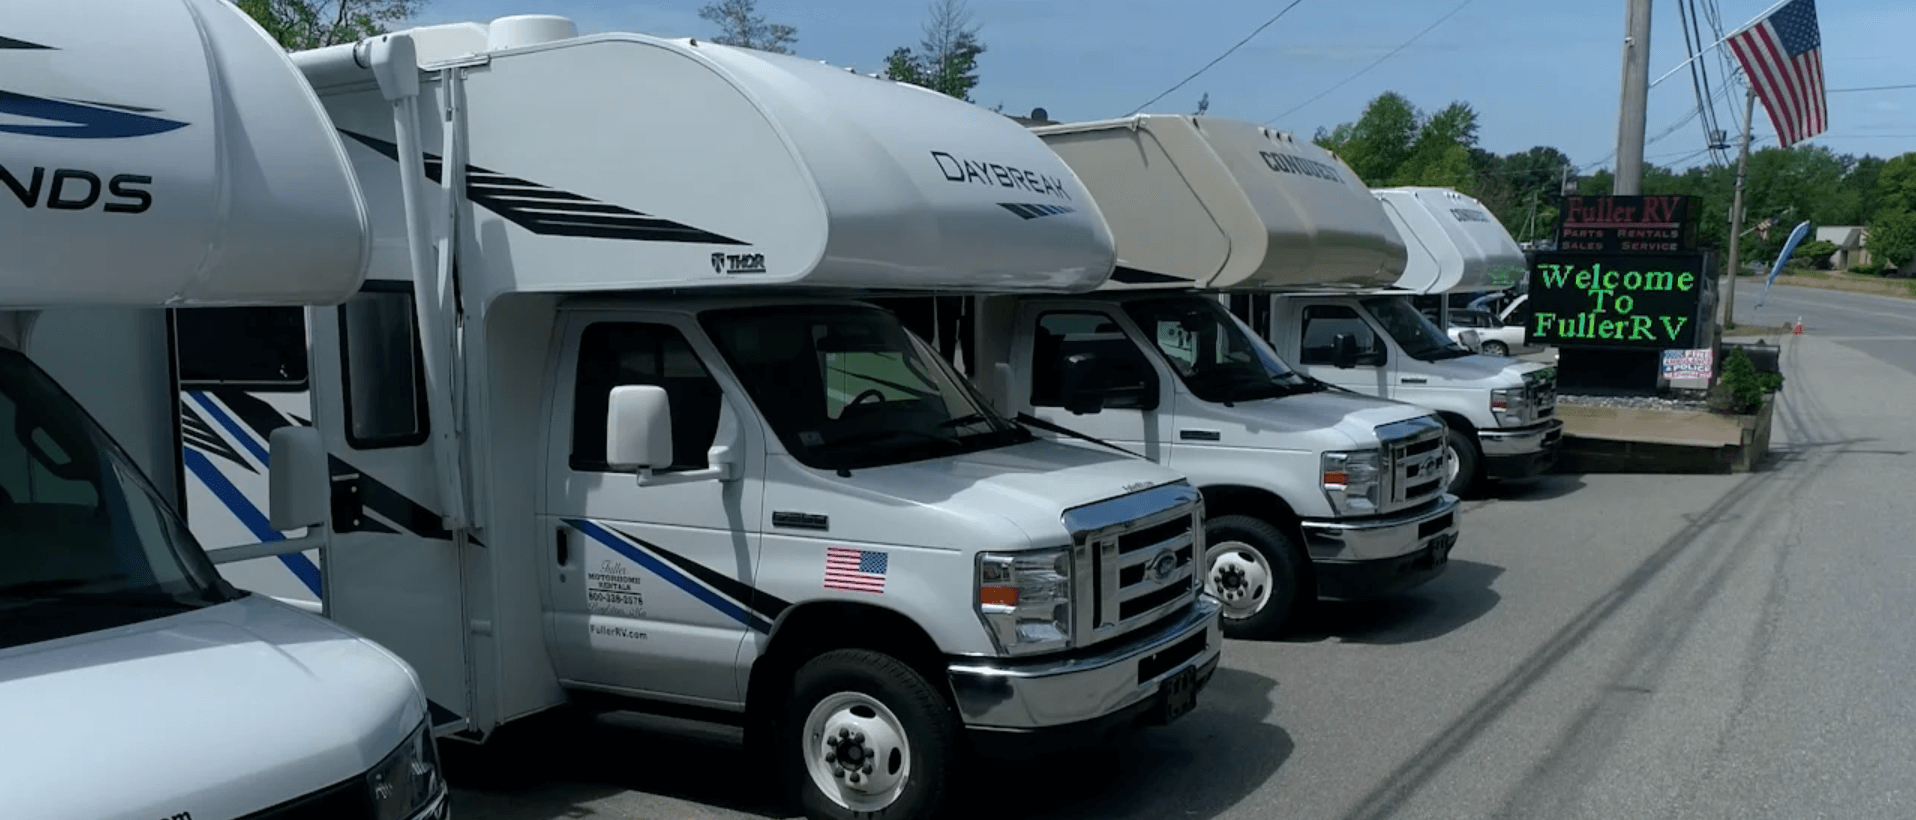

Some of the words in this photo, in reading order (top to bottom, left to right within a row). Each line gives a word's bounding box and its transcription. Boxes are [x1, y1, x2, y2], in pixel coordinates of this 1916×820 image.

[1259, 150, 1345, 184] CONQUEST
[1566, 197, 1635, 222] Fuller
[1641, 196, 1681, 222] RV
[726, 253, 766, 270] THOR
[1537, 263, 1694, 291] Welcome
[1588, 289, 1634, 314] To
[588, 573, 641, 585] MOTORHOME
[598, 582, 631, 591] RENTALS
[590, 624, 648, 640] FullerRV.com
